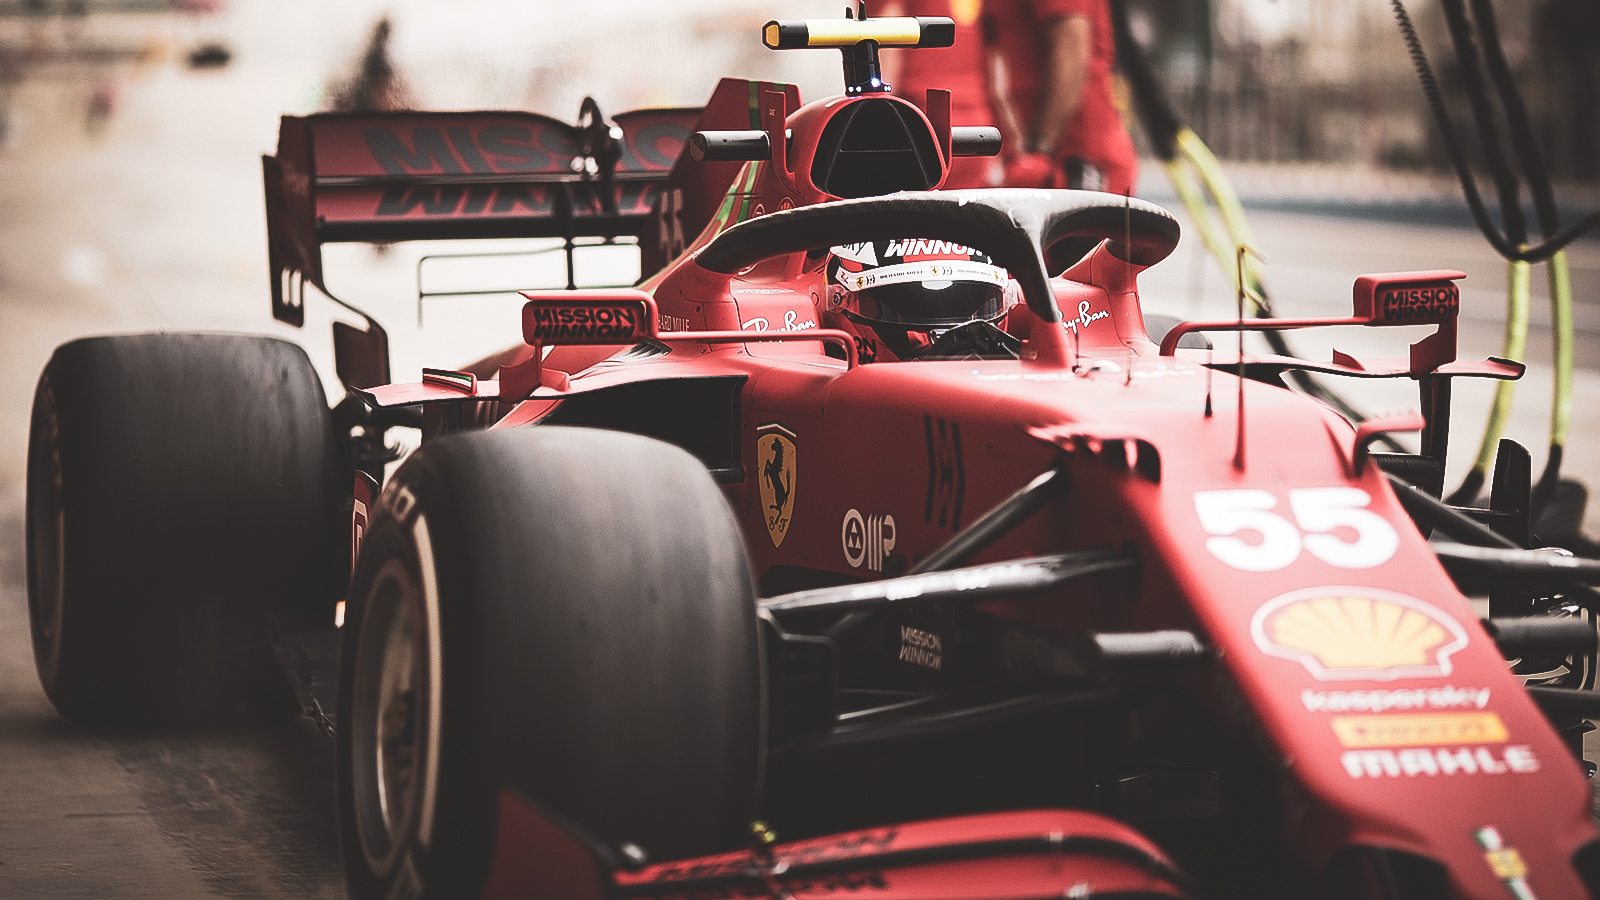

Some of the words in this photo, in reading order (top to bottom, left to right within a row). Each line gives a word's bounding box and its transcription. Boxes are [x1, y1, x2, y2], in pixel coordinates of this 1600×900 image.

[1383, 288, 1457, 307] MISSION
[533, 308, 635, 324] MISSION
[533, 325, 635, 339] WINNOW
[1193, 487, 1400, 572] 55
[900, 625, 941, 651] MISSION
[1341, 746, 1530, 778] MAHLE
